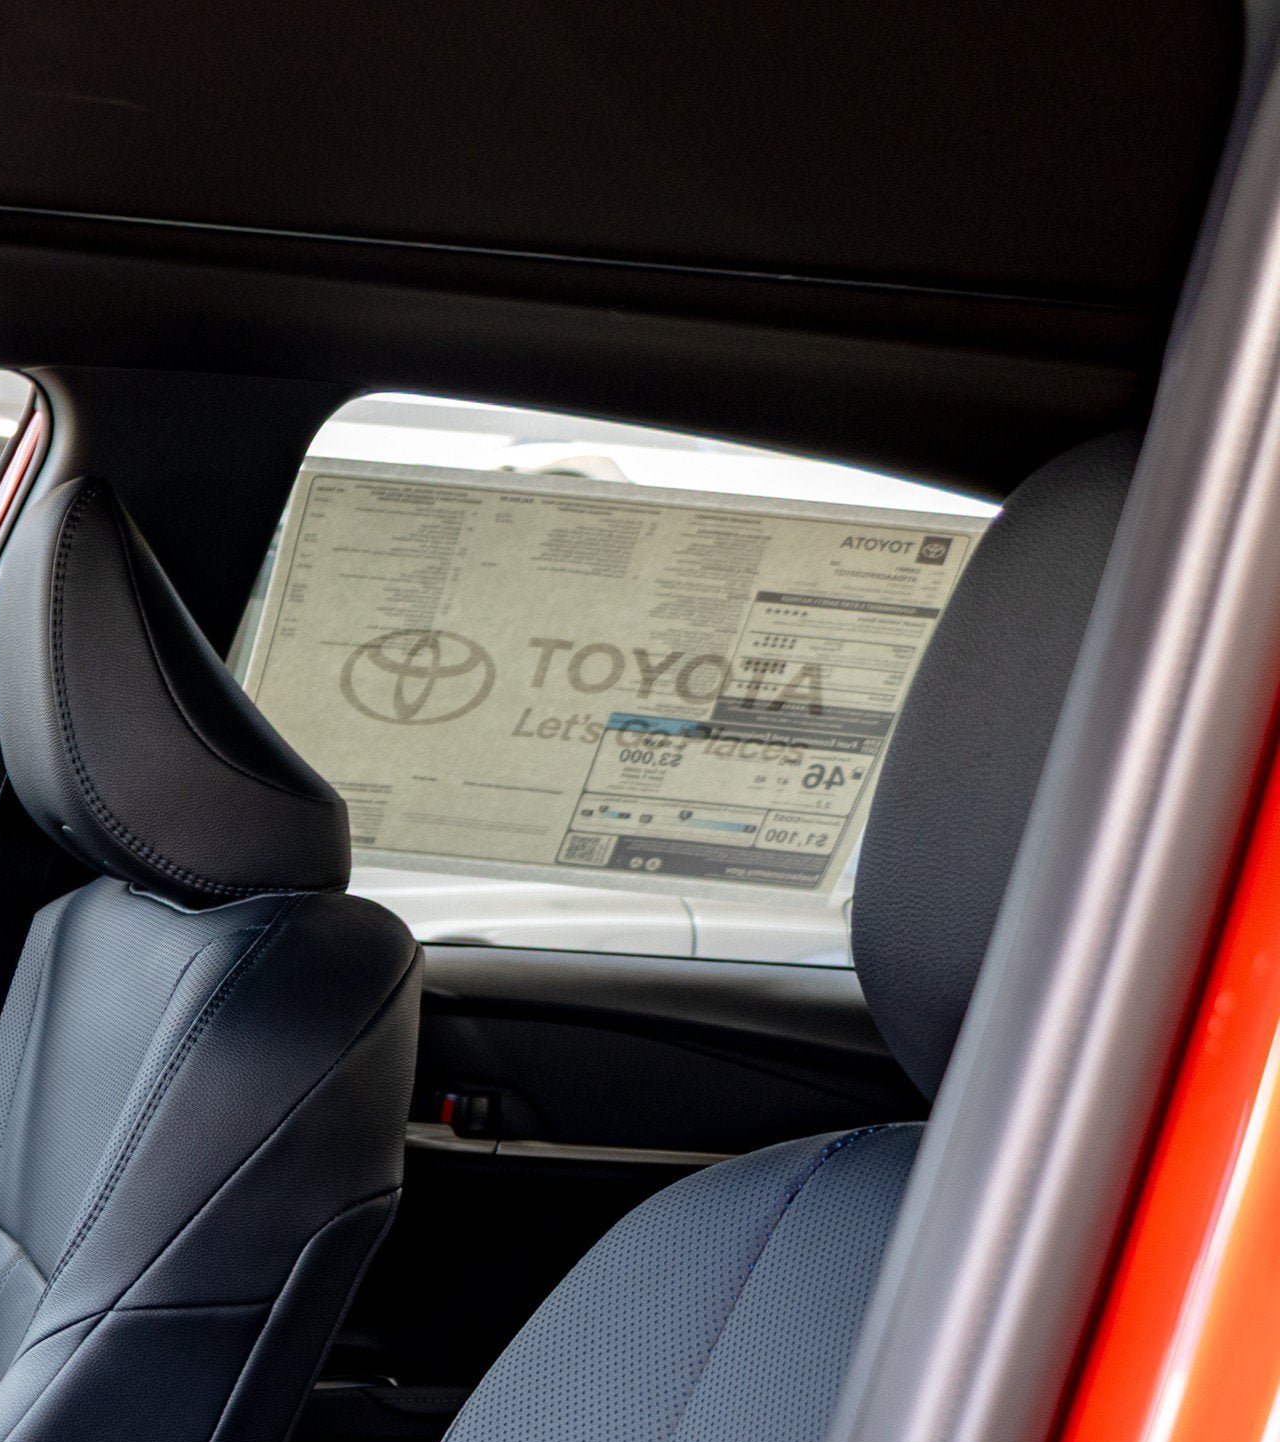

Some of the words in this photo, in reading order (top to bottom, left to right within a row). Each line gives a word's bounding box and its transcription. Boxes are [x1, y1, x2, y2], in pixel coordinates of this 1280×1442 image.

[526, 635, 824, 717] TOYOTA
[510, 707, 606, 744] Let's
[615, 719, 671, 748] Go
[678, 725, 808, 764] Places
